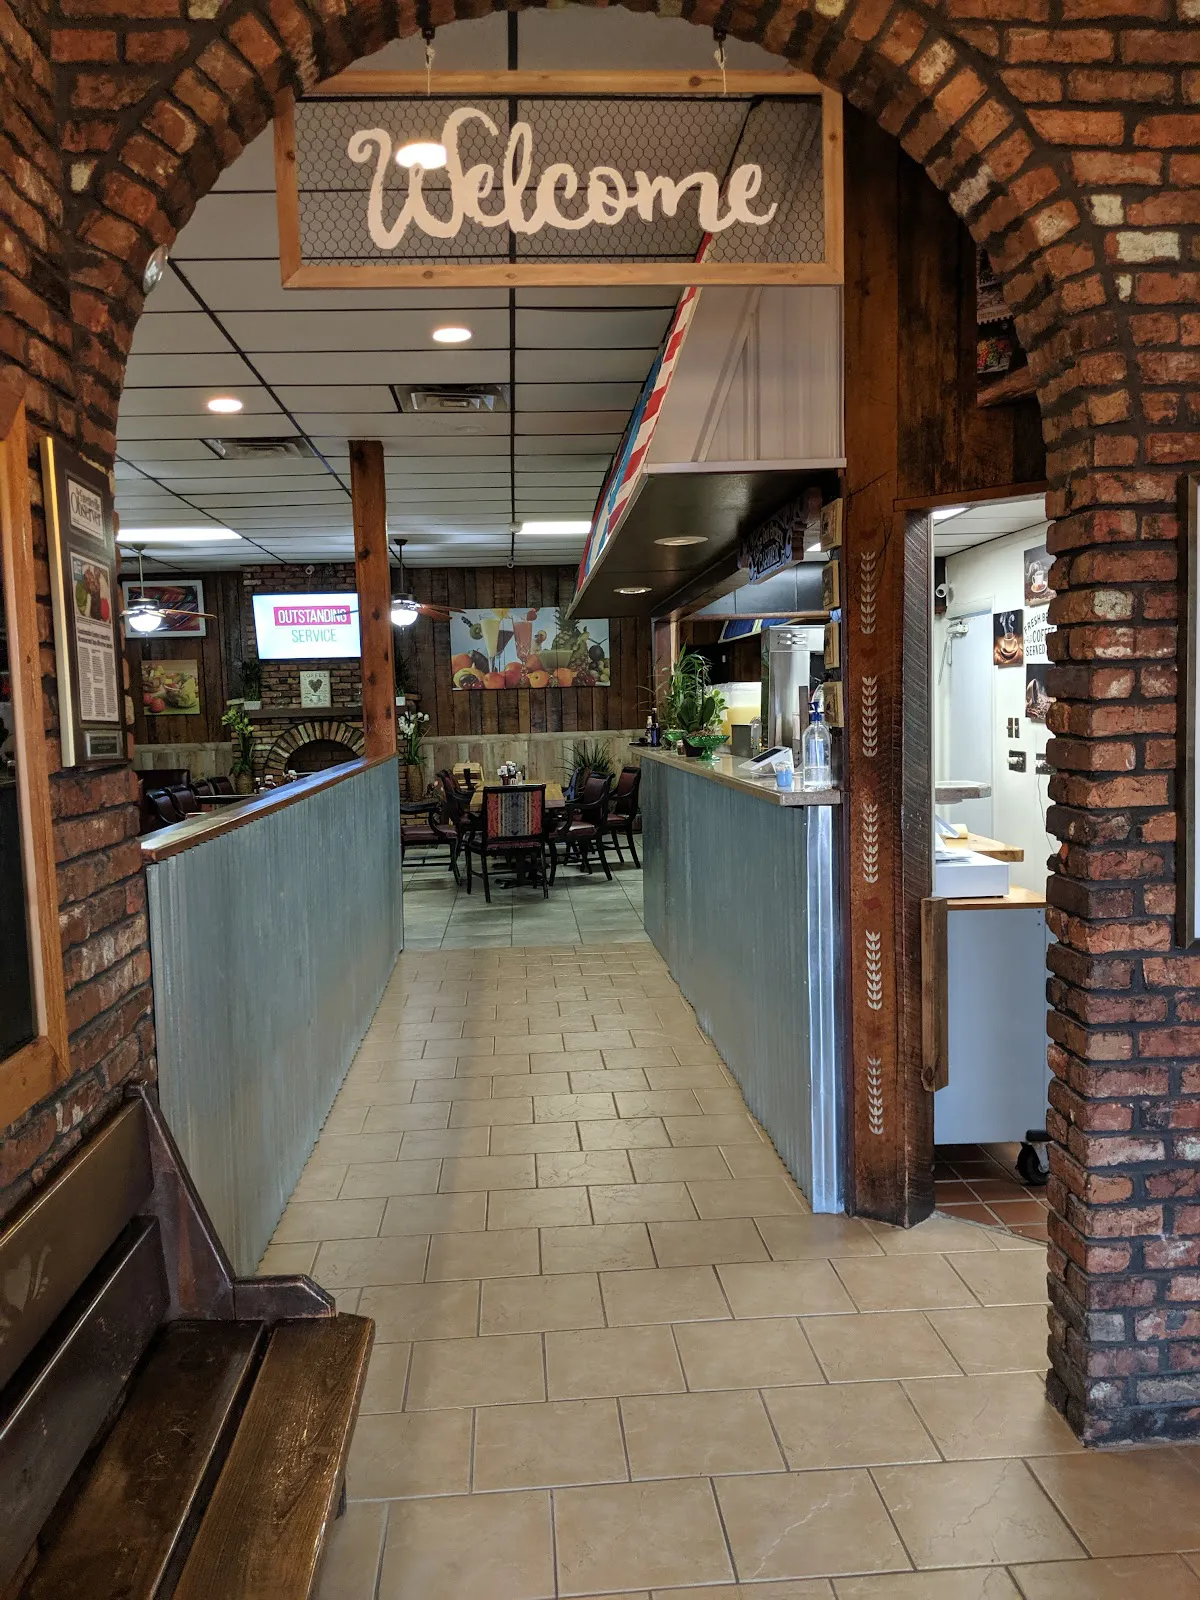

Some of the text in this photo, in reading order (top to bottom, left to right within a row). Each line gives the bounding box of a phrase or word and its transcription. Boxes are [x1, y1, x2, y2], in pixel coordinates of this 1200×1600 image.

[348, 107, 777, 250] Welcome
[278, 609, 347, 623] OUTSTANDING
[1024, 613, 1041, 634] FRESH
[291, 628, 337, 643] SERVICE
[1026, 644, 1045, 656] SERVED
